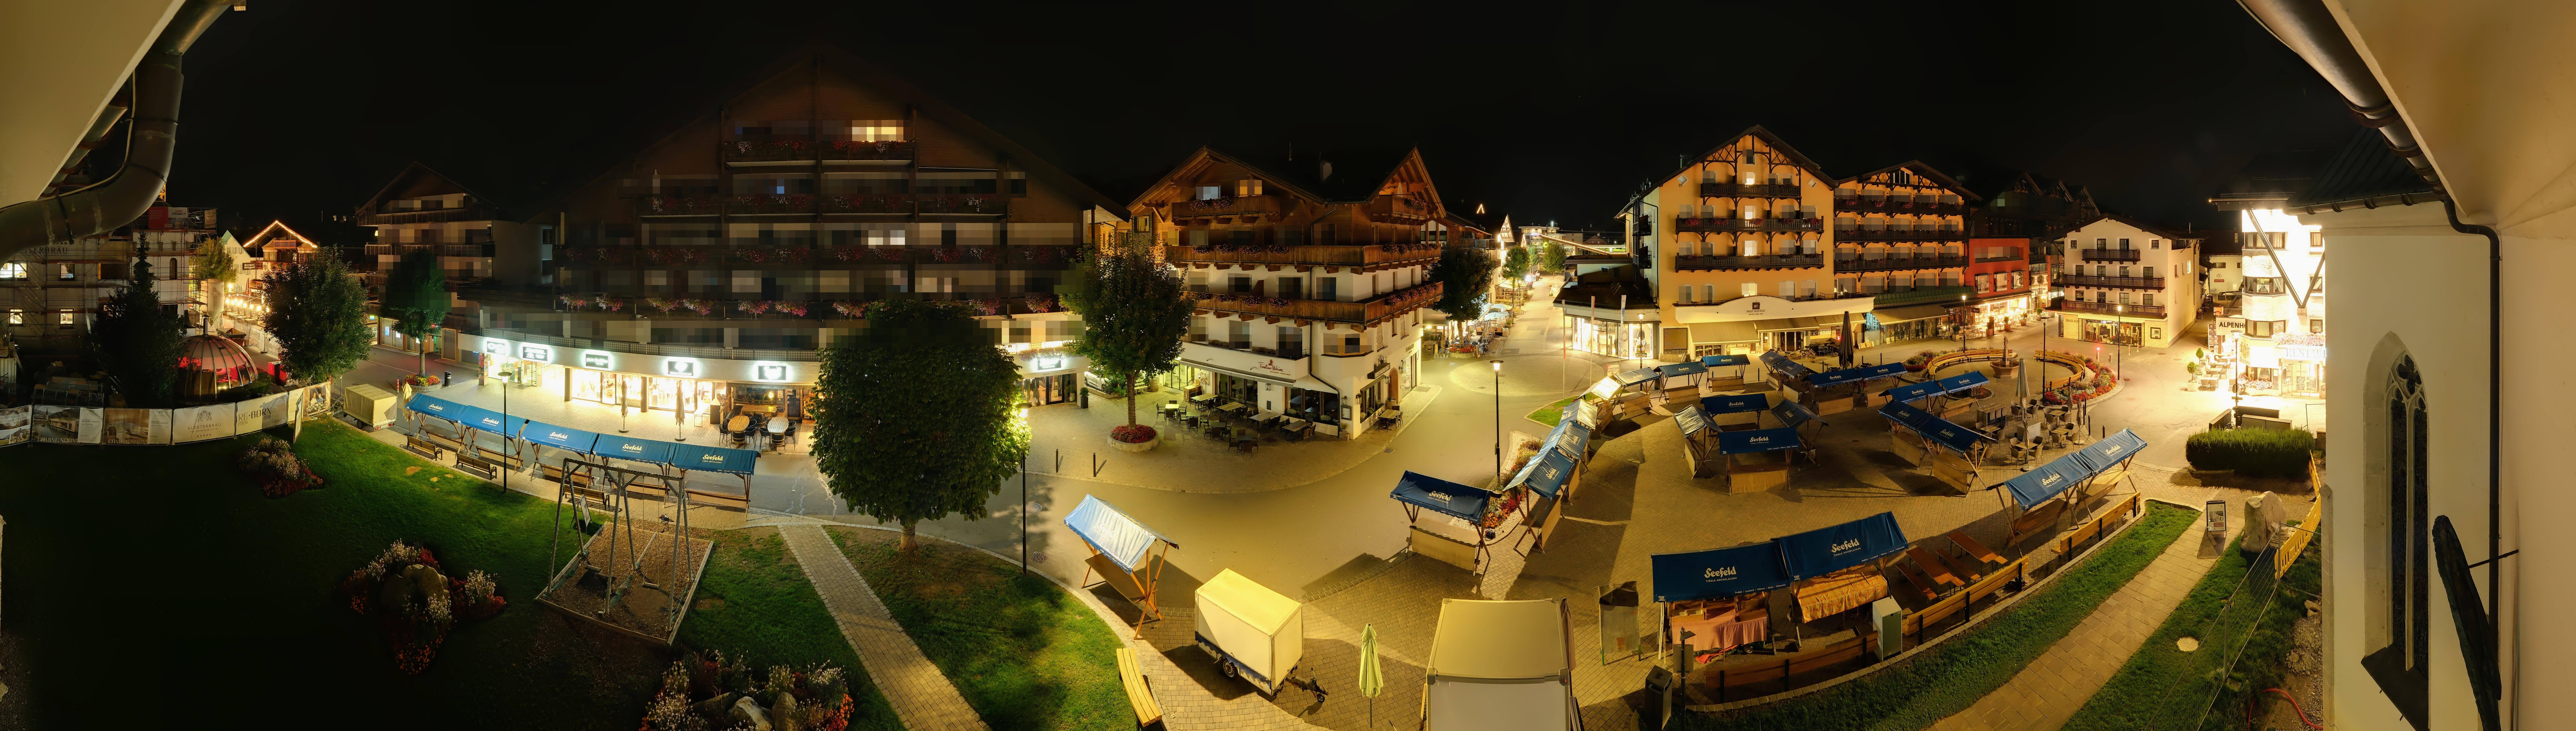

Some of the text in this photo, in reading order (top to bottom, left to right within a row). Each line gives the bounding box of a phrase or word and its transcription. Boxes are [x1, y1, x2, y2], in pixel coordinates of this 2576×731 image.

[1406, 343, 1414, 352] SAILER
[1375, 364, 1389, 377] RESTAURANT
[2106, 445, 2121, 455] Seefeld
[1546, 468, 1556, 479] Seefeld
[2042, 473, 2060, 485] Seefeld
[1429, 491, 1452, 501] Seefeld
[1097, 523, 1116, 539] Seefeld
[1831, 538, 1860, 552] Seefeld
[1704, 566, 1736, 578] Seefeld
